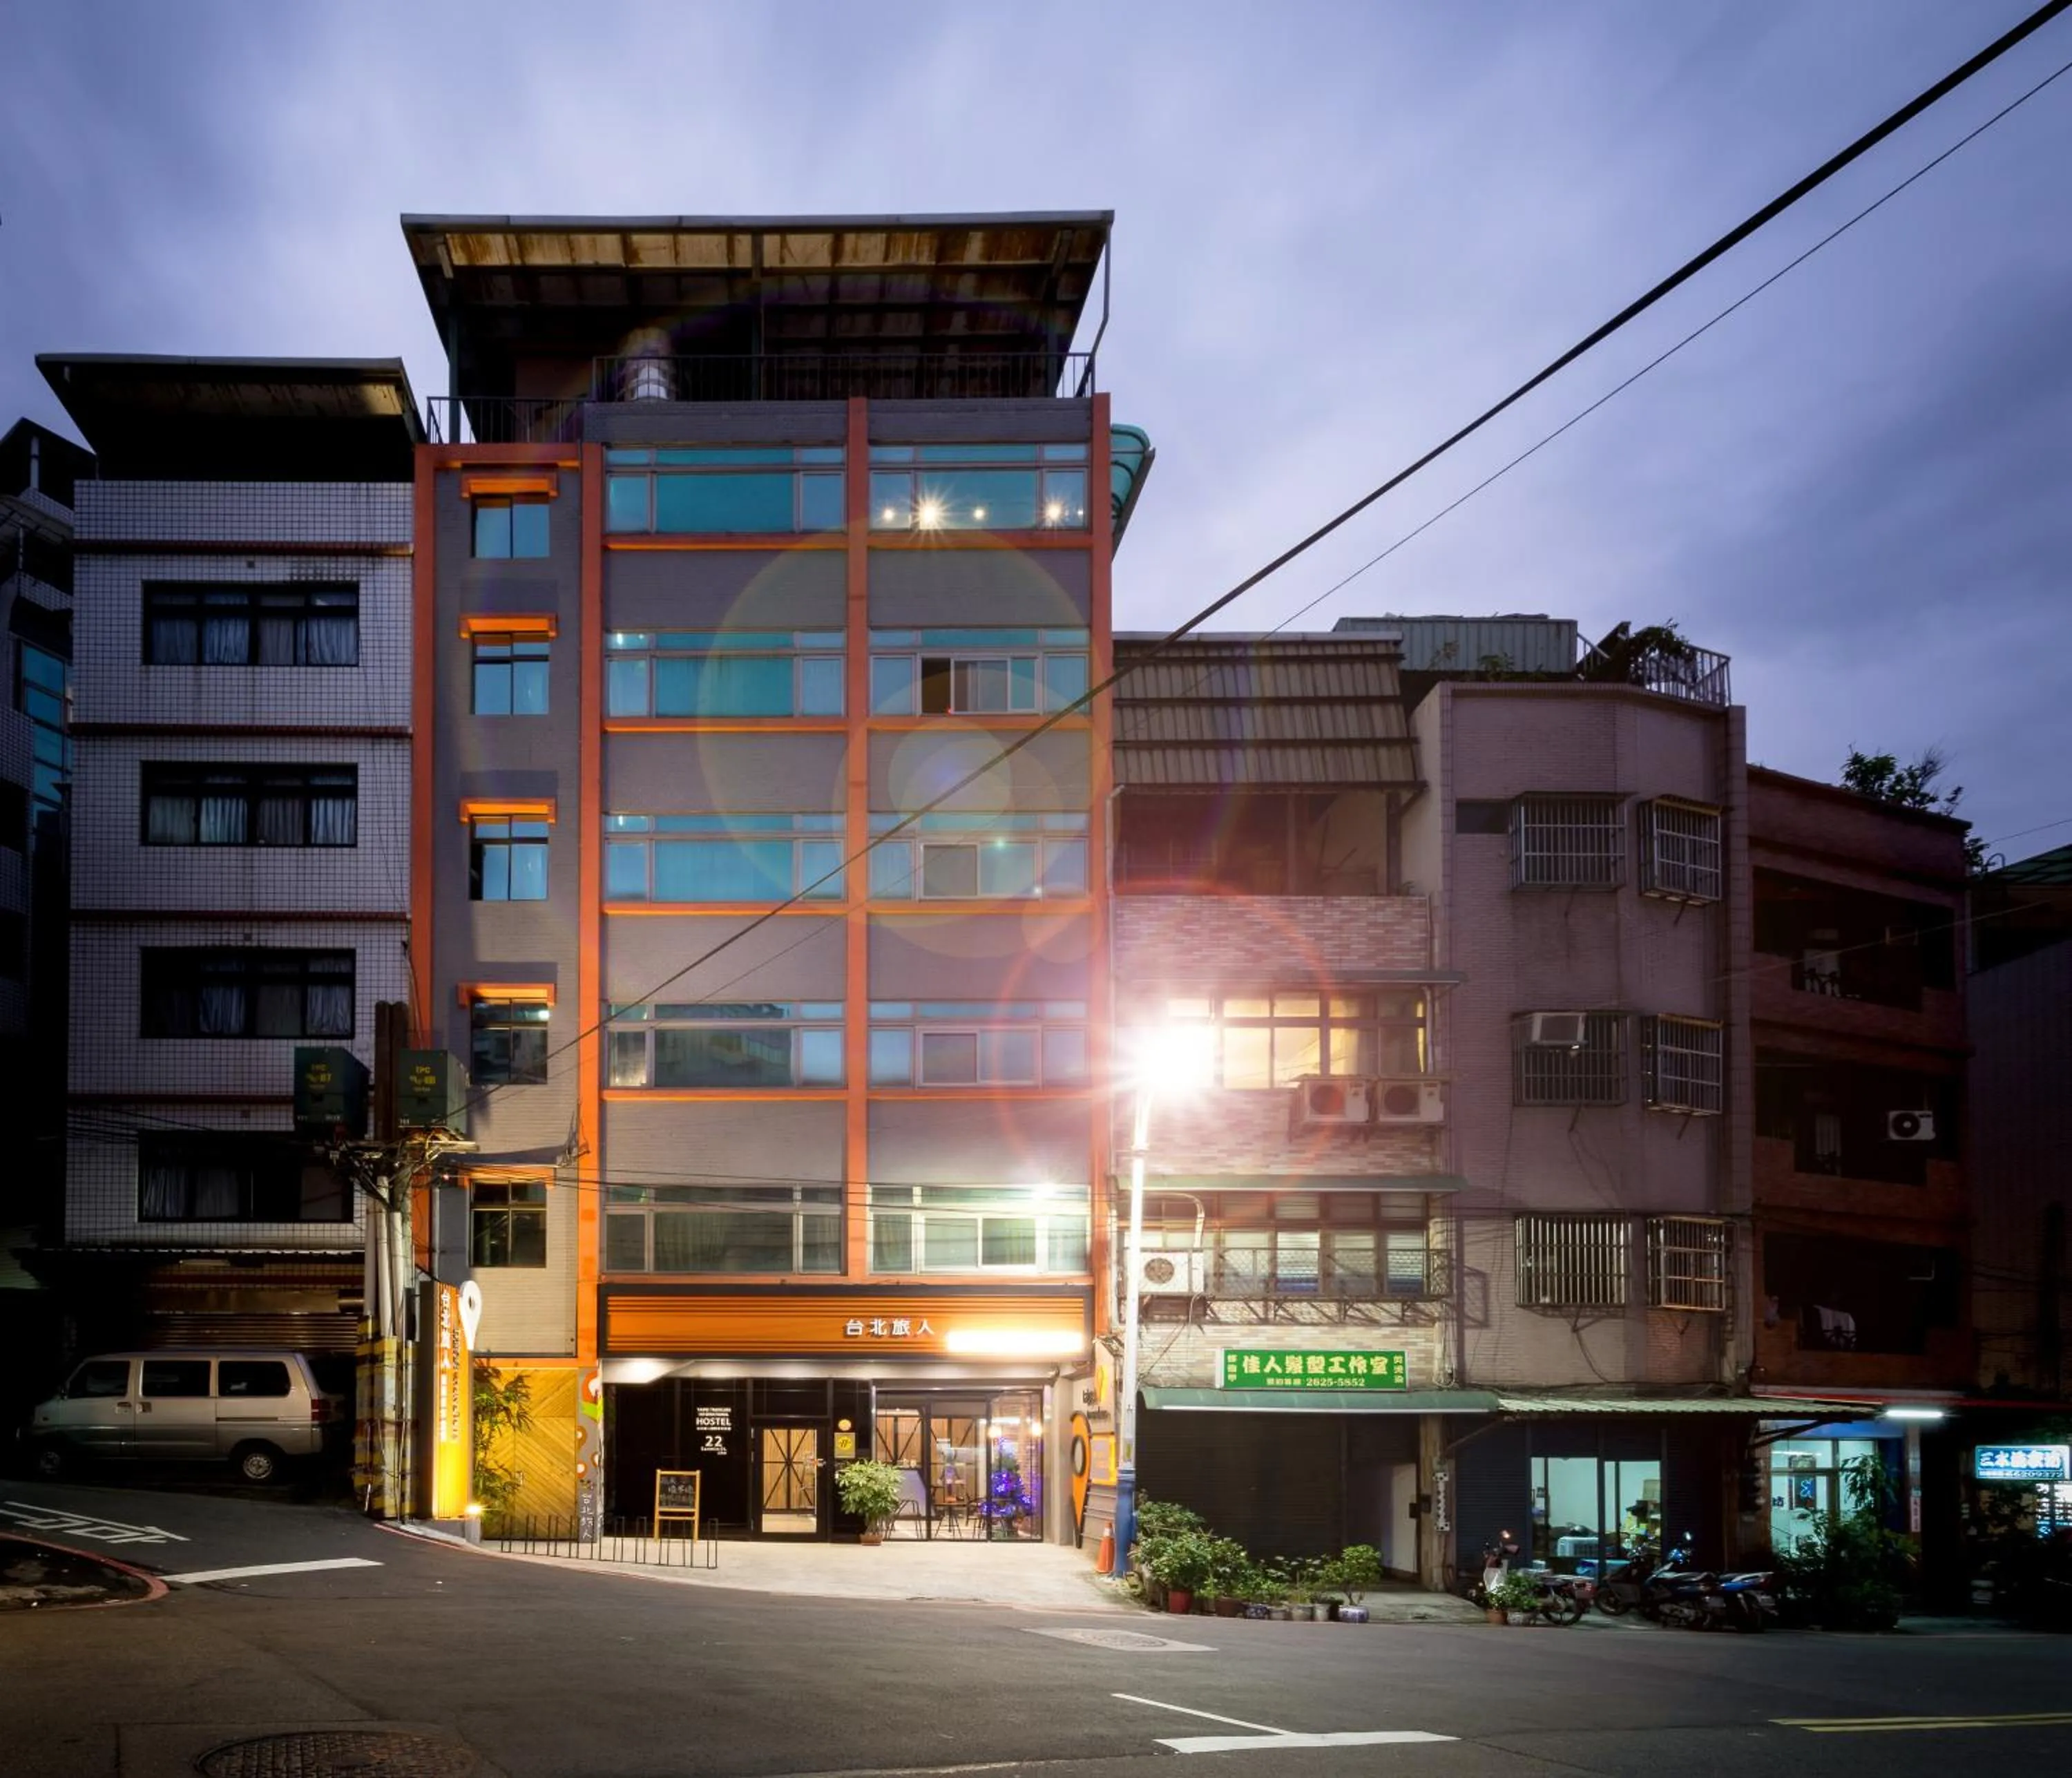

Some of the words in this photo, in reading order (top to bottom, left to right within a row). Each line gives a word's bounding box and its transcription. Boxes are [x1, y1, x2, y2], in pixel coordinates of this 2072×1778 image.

[845, 1318, 934, 1336] 台北旅人
[696, 1417, 731, 1426] HOSTEL
[705, 1435, 722, 1447] 22
